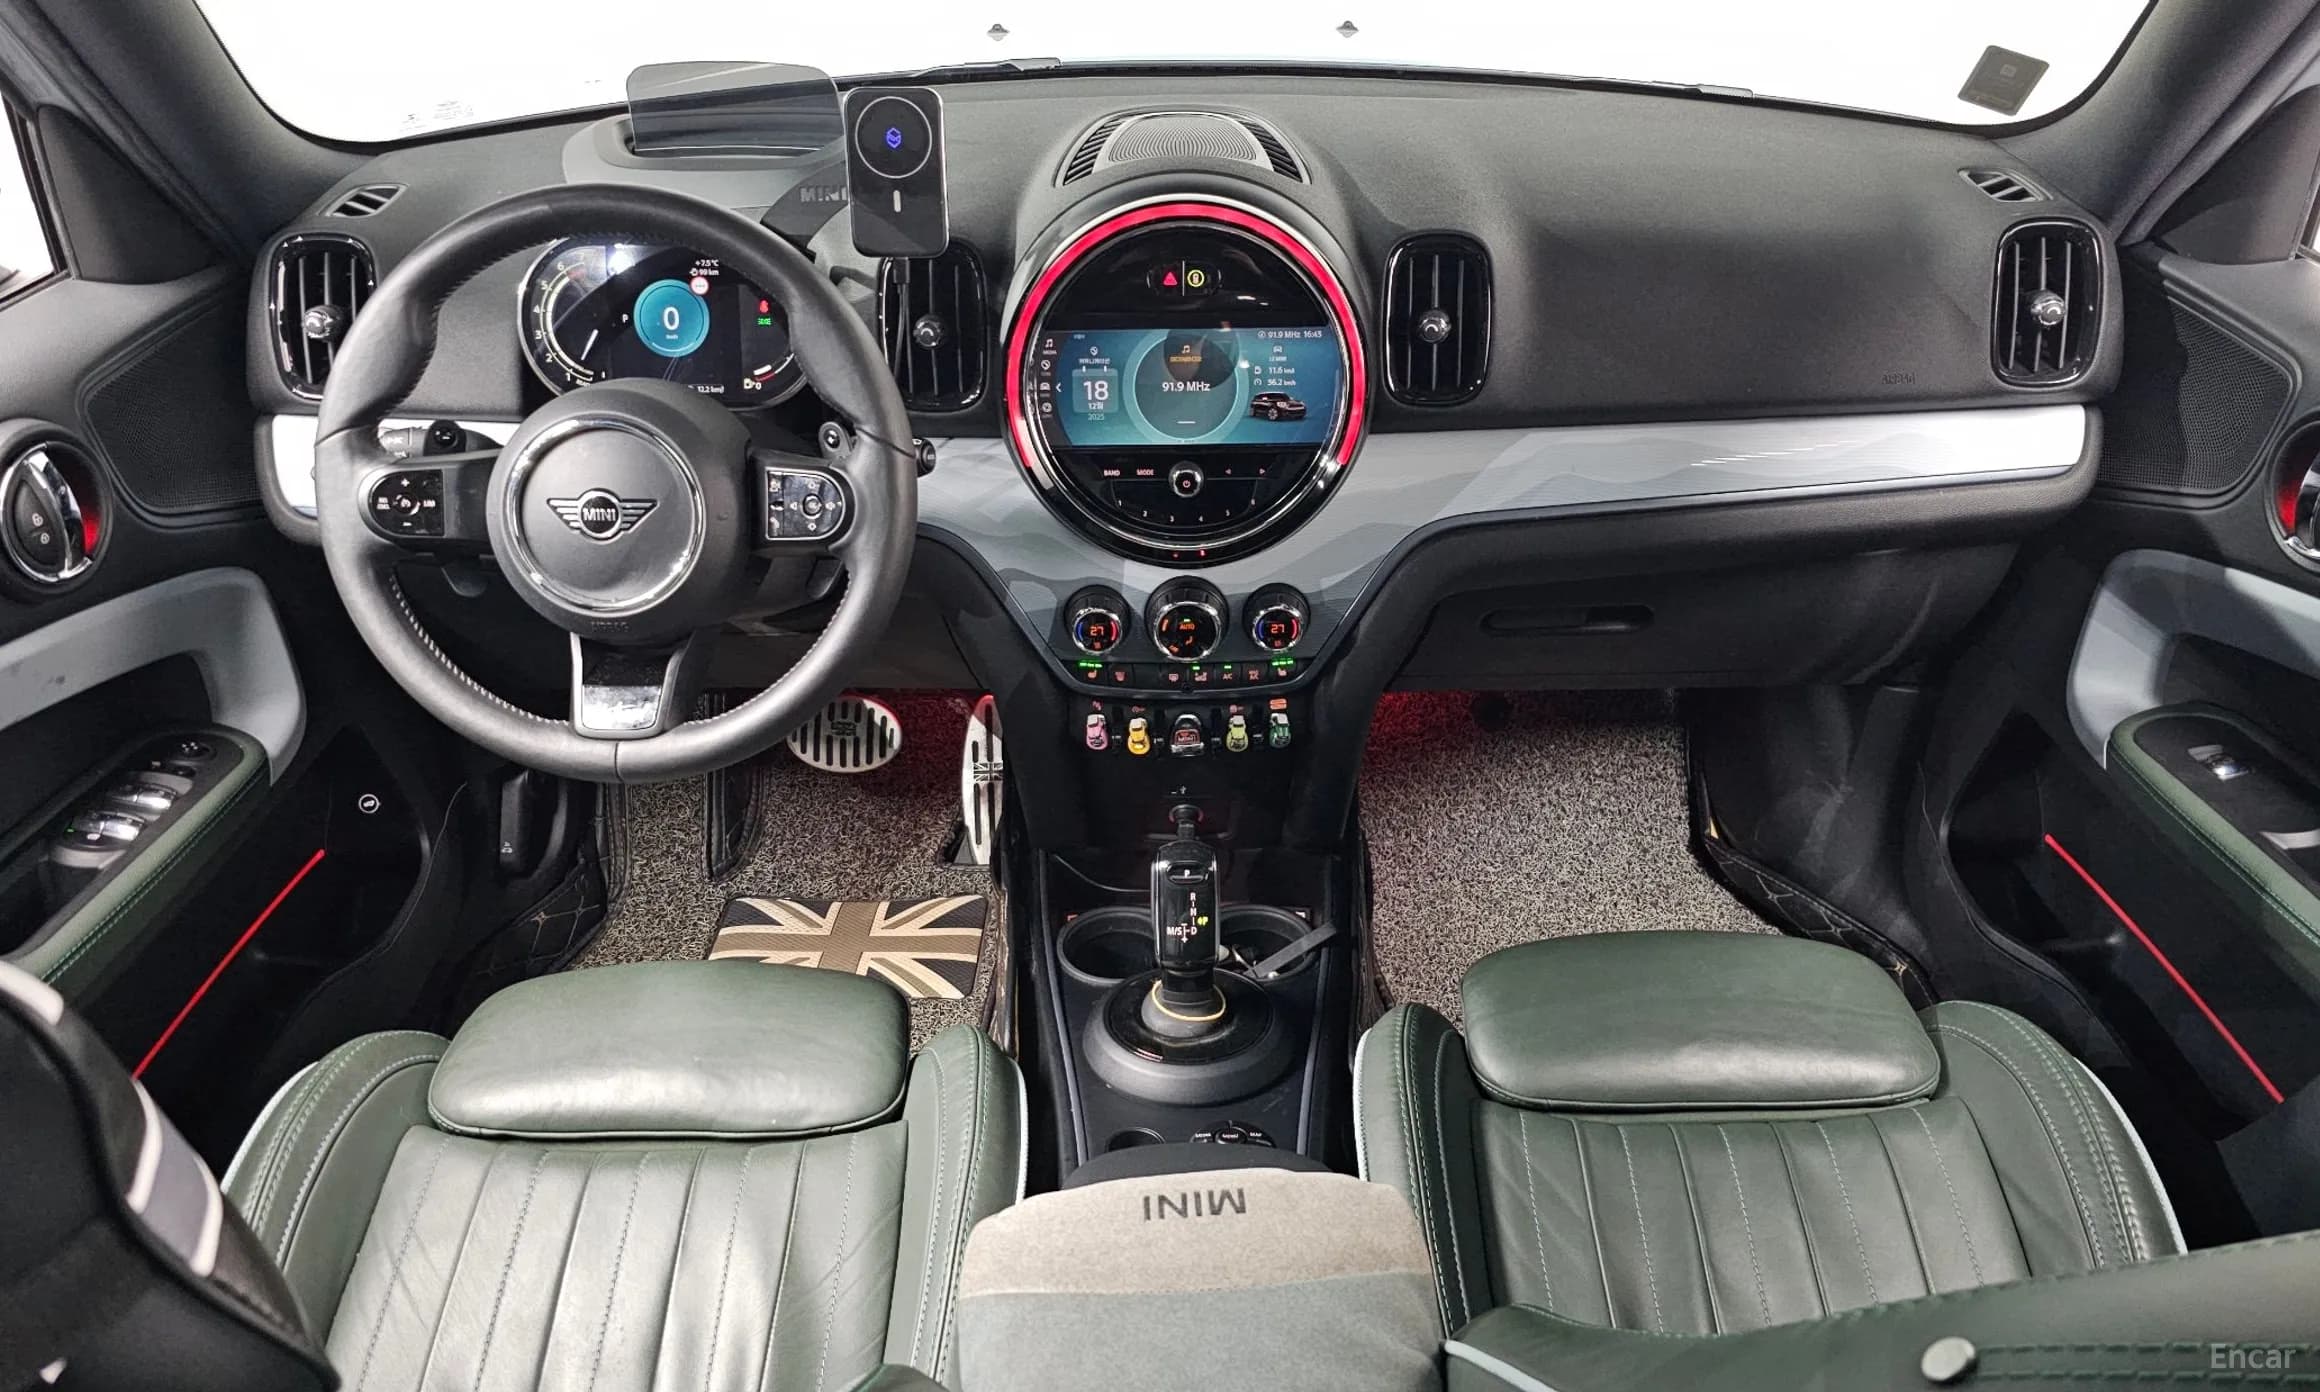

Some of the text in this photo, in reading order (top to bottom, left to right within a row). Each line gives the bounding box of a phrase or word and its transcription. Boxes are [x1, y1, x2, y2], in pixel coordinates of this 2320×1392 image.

[533, 304, 541, 314] 4
[663, 306, 680, 331] 0
[535, 330, 543, 340] 3
[1284, 330, 1302, 339] MHz
[545, 353, 553, 363] 2
[1083, 380, 1110, 401] 18
[1162, 381, 1211, 393] 91.9 MHz
[1103, 469, 1121, 477] BAND
[1136, 468, 1155, 476] MODE
[582, 508, 616, 522] MINI
[1090, 625, 1105, 637] 27
[1179, 622, 1196, 630] AUTO
[1271, 623, 1285, 634] 27
[1222, 673, 1233, 681] AC
[1184, 869, 1191, 878] P
[1190, 892, 1197, 901] R
[1190, 907, 1197, 917] N
[1166, 926, 1182, 936] M/S
[1190, 926, 1198, 936] D
[1143, 1187, 1247, 1222] MINI
